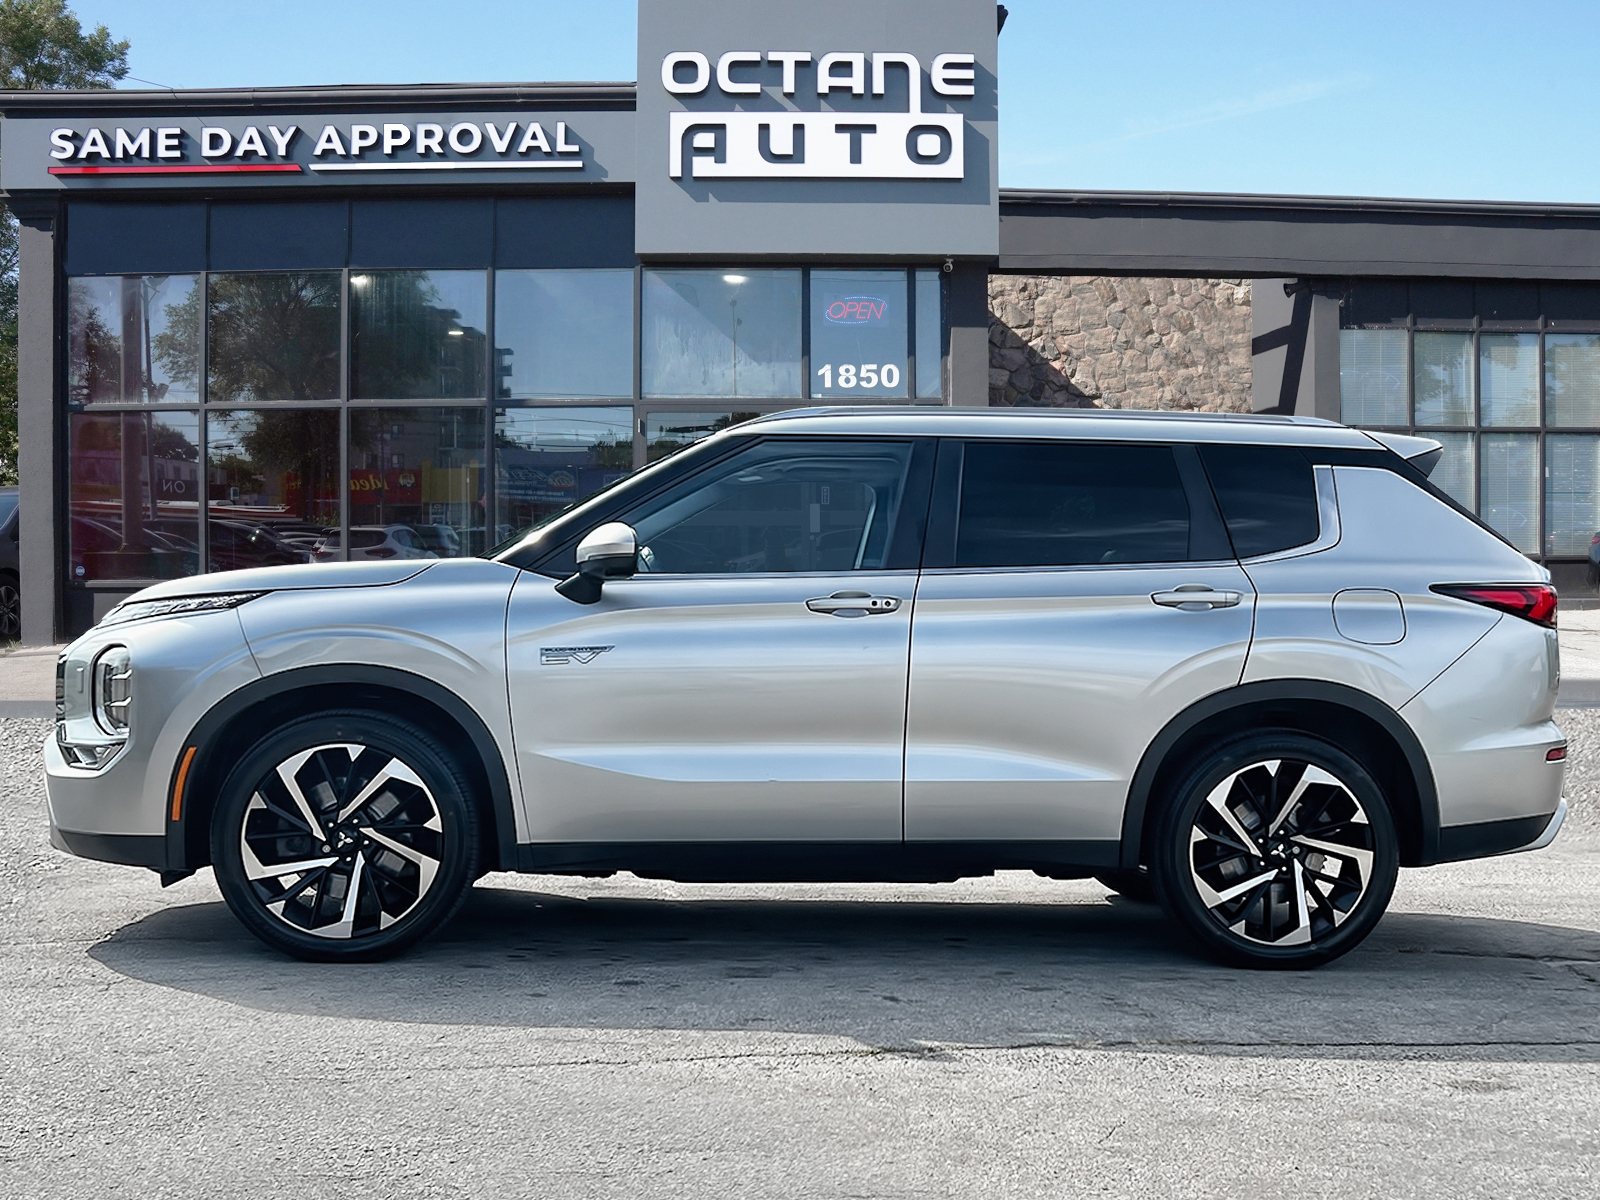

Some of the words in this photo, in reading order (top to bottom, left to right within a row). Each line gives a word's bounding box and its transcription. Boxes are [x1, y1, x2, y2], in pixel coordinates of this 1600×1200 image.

[660, 50, 975, 112] OCTANE
[49, 126, 182, 159] SAME
[201, 125, 298, 157] DAY
[312, 121, 580, 156] APPROVAL
[680, 123, 953, 177] AUTO
[828, 301, 885, 319] OPEN
[817, 363, 900, 388] 1850
[541, 652, 603, 665] EV
